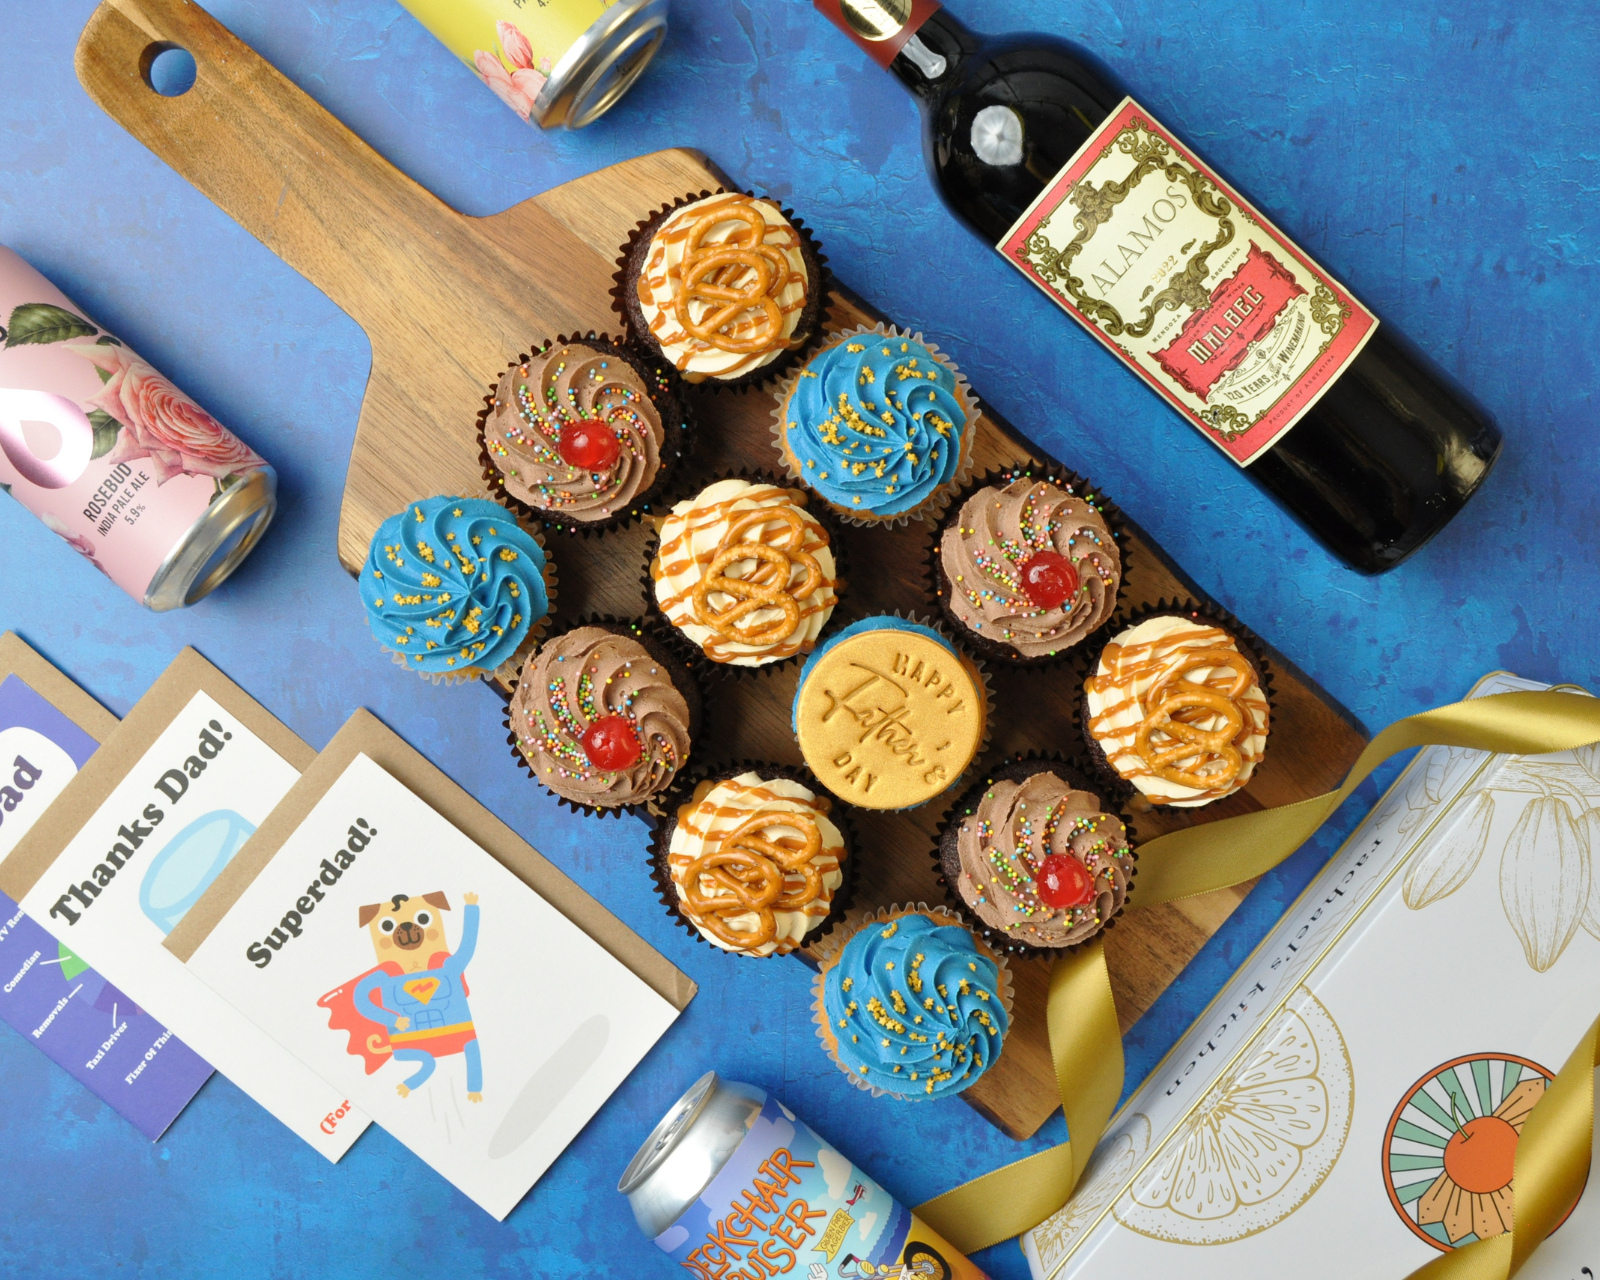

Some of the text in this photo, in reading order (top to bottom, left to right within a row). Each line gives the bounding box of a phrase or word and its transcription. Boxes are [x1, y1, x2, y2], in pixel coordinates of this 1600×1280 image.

[1091, 185, 1187, 297] ALAMOS
[1210, 247, 1240, 281] ARGENTINA
[1151, 255, 1178, 285] 2022
[1152, 313, 1182, 343] MENDOZA
[1186, 284, 1265, 365] MALBEC
[1200, 300, 1226, 328] ALTITUDE
[1226, 282, 1245, 299] WINES
[1223, 389, 1244, 401] 120
[1241, 374, 1271, 395] YEARS
[1277, 311, 1306, 364] WINEMAKING
[1268, 355, 1335, 425] PRODUCT OF ARGENTINA
[83, 462, 132, 523] ROSEBUD
[97, 471, 150, 537] INDIA PALE ALE
[124, 503, 146, 525] 5.9%
[892, 652, 966, 715] HAPPY
[0, 754, 42, 827] ad
[833, 752, 878, 793] DAY
[50, 719, 233, 926] Thanks Dad!
[246, 817, 378, 969] Superdad!
[3, 950, 41, 993] Comedian
[1164, 837, 1384, 1097] rachael's kitchen
[32, 997, 69, 1039] Removals
[86, 1021, 128, 1070] Taxi Driver
[125, 1060, 147, 1085] Fixer
[144, 1047, 157, 1061] Of
[320, 1099, 351, 1135] (For
[680, 1147, 815, 1280] DECKCHAIR
[819, 1223, 836, 1250] GLUTEN
[826, 1229, 842, 1255] LAGER
